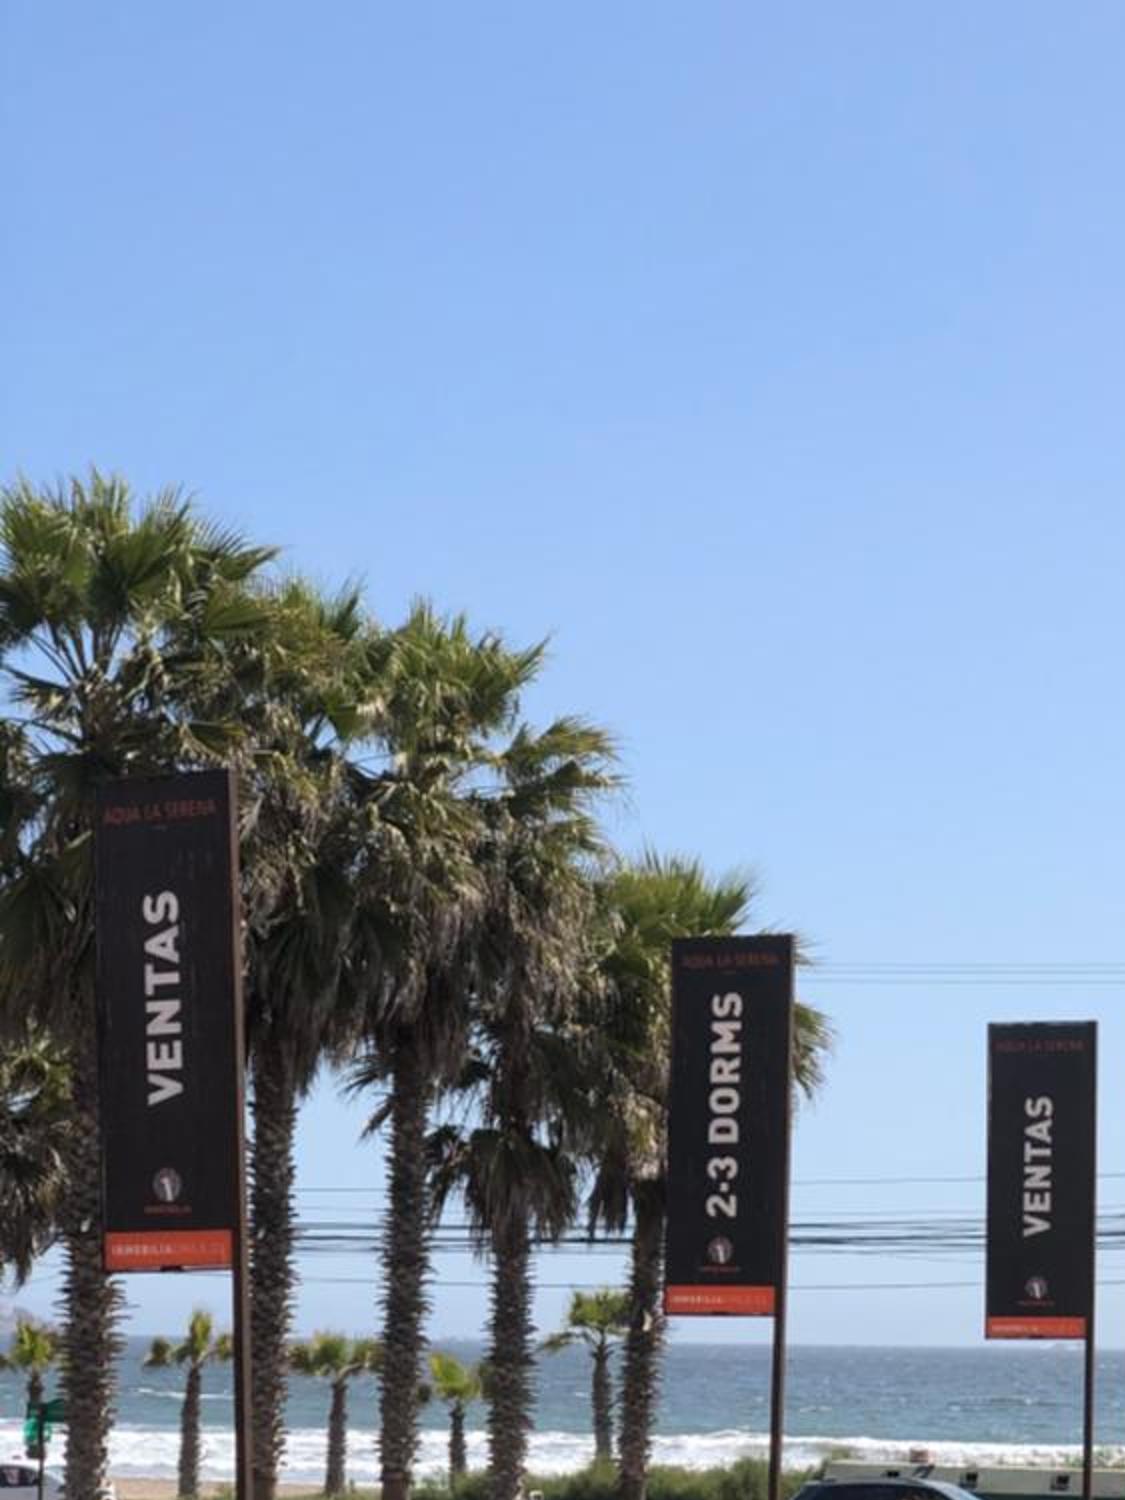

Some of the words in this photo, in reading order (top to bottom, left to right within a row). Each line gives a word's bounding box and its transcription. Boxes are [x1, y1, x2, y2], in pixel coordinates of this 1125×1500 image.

[143, 890, 183, 1106] VENTAS
[708, 992, 744, 1144] DORMS
[1023, 1096, 1054, 1238] VENTAS
